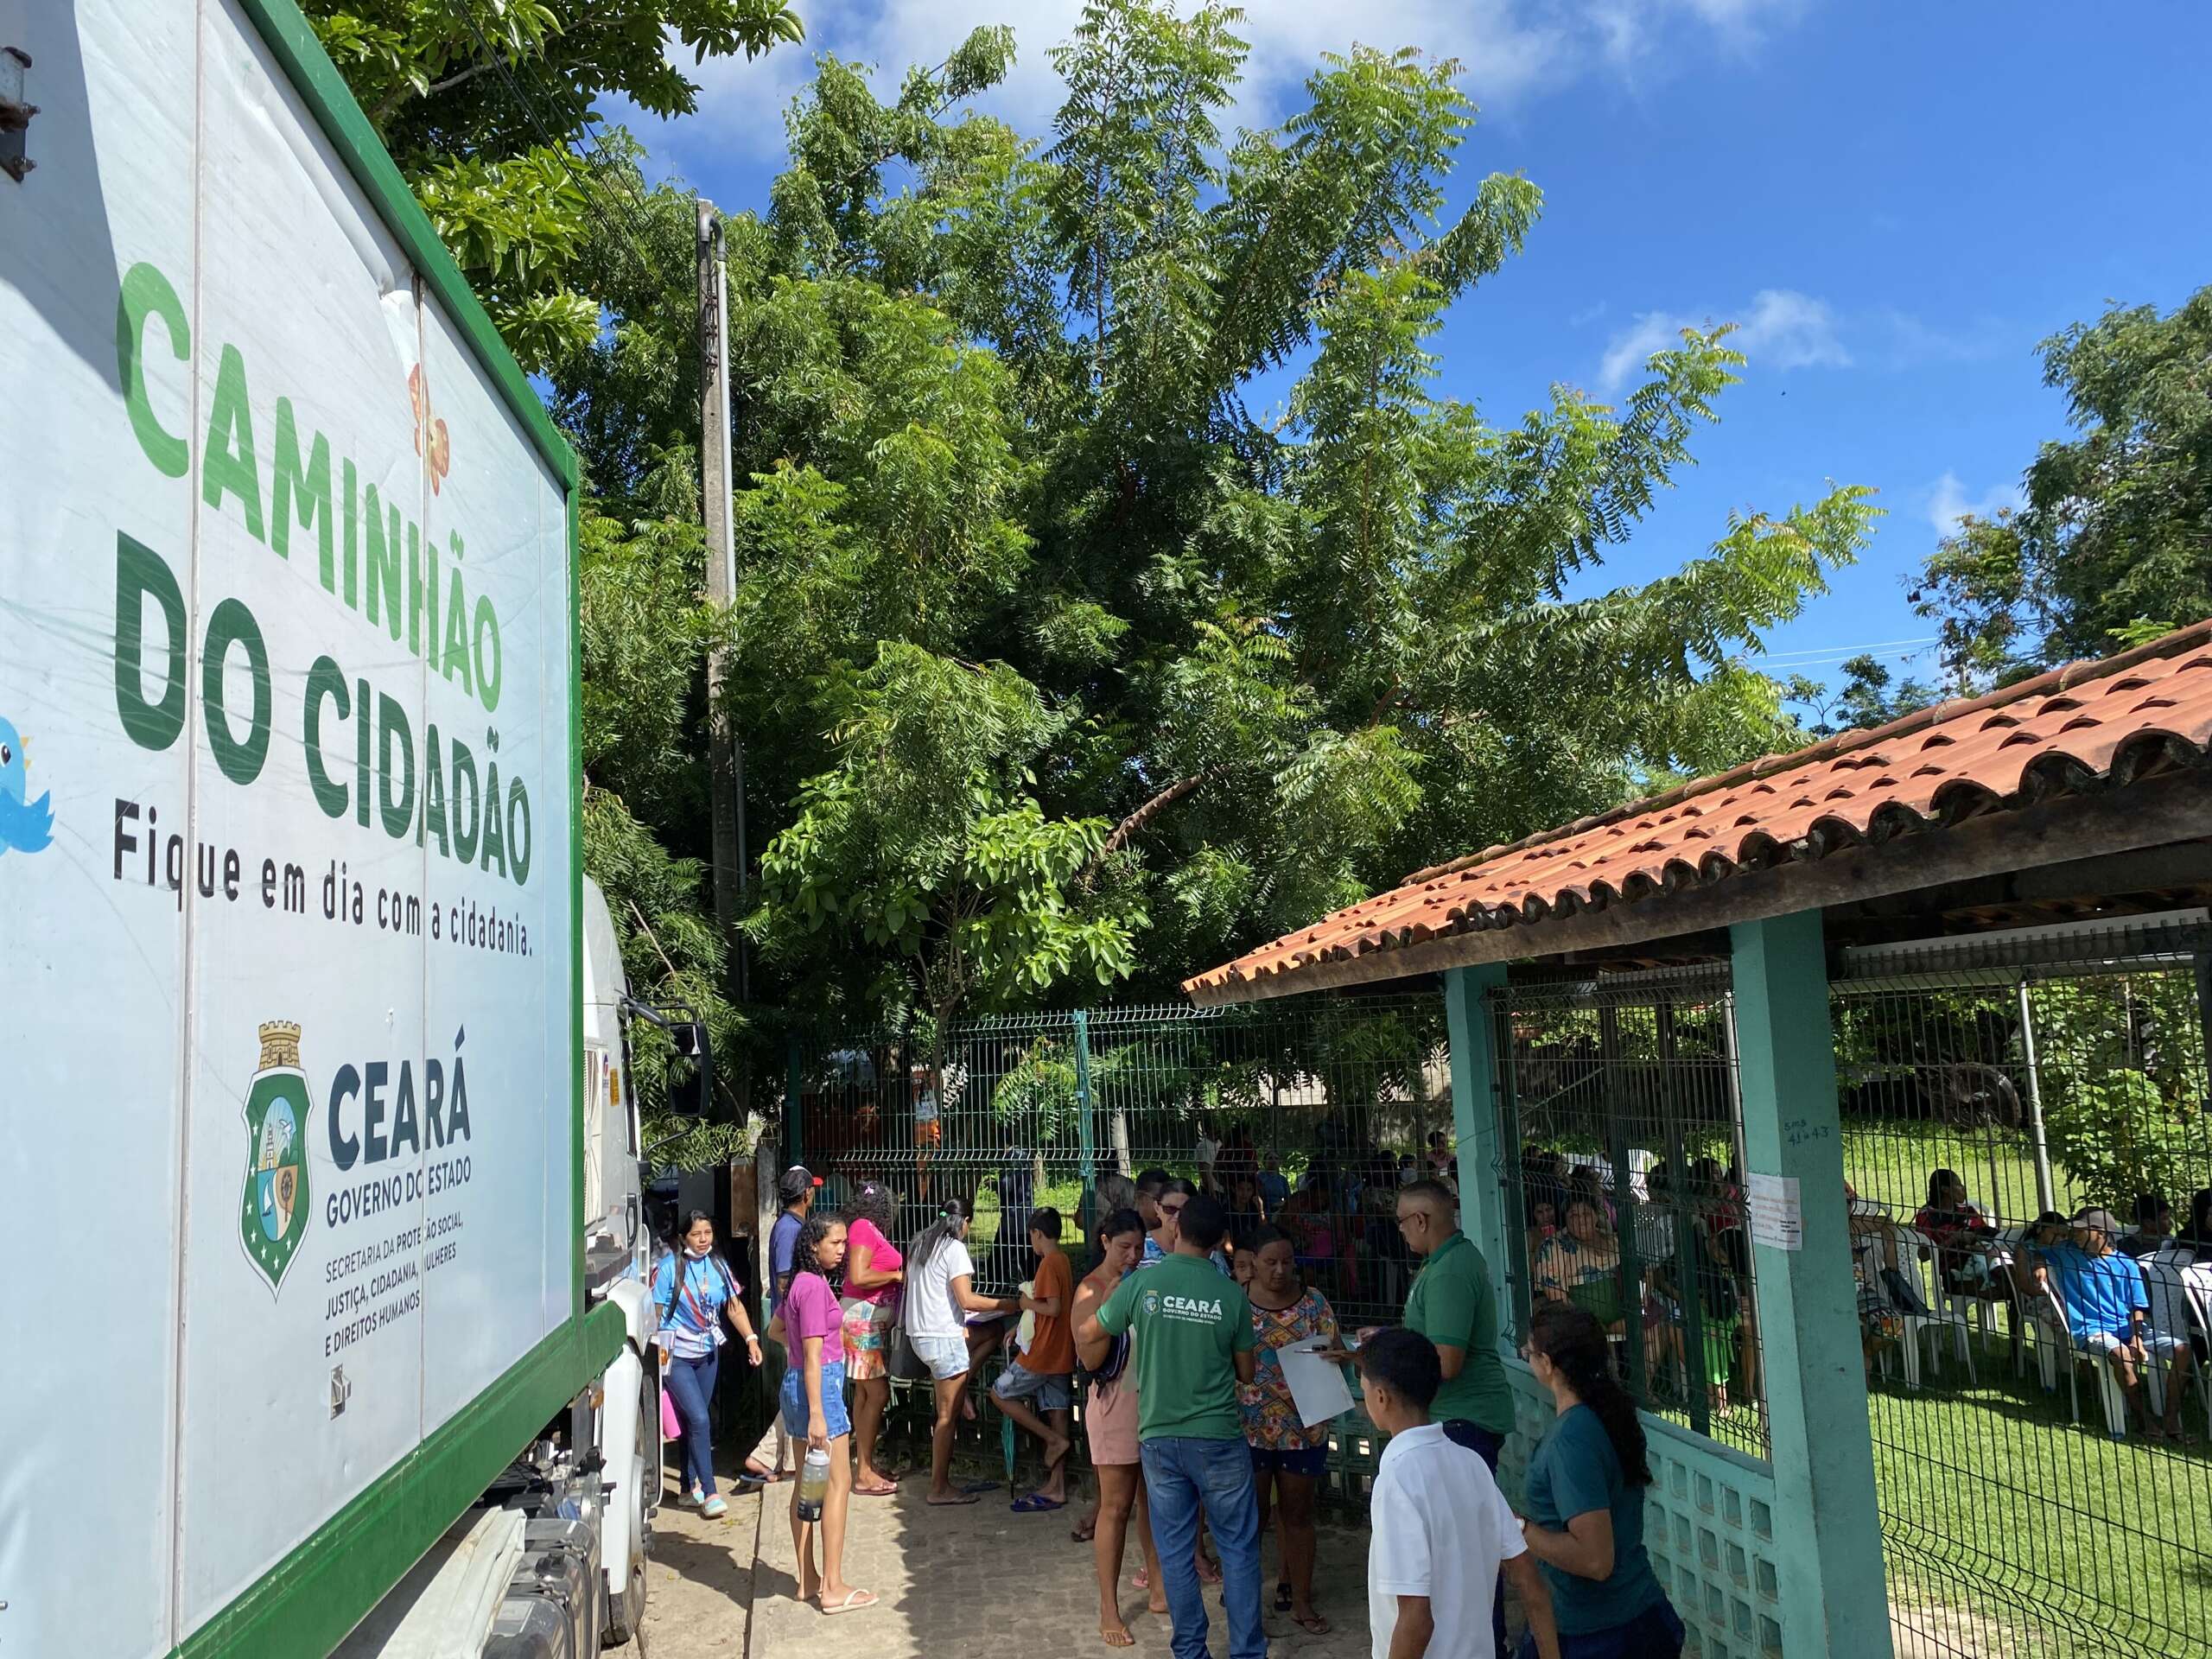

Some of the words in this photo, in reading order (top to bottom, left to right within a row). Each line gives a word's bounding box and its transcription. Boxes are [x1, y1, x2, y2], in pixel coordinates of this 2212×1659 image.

[116, 262, 501, 713] CAMINHÃO
[115, 529, 271, 785] DO
[303, 654, 531, 887] CIDADÃO
[114, 798, 240, 912] Fique
[262, 858, 305, 914] em
[323, 859, 363, 925] dia
[378, 888, 421, 936] com
[432, 902, 441, 939] a
[450, 896, 532, 957] cidadania.
[327, 1023, 471, 1172] CEARÁ
[327, 1174, 403, 1229] GOVERNO
[406, 1169, 423, 1203] DO
[429, 1155, 471, 1196] ESTADO
[326, 1244, 382, 1283] SECRETARIA
[383, 1239, 395, 1260] DA
[397, 1217, 437, 1254] PROTEÃO
[438, 1211, 464, 1237] SOCIAL,
[325, 1333, 332, 1357] E
[334, 1312, 378, 1354] DIREITOS
[378, 1289, 420, 1328] HUMANOS
[326, 1284, 369, 1320] JUSTIÇA,
[371, 1260, 419, 1298] CIDADANIA,
[1163, 1295, 1222, 1315] CEARÁ
